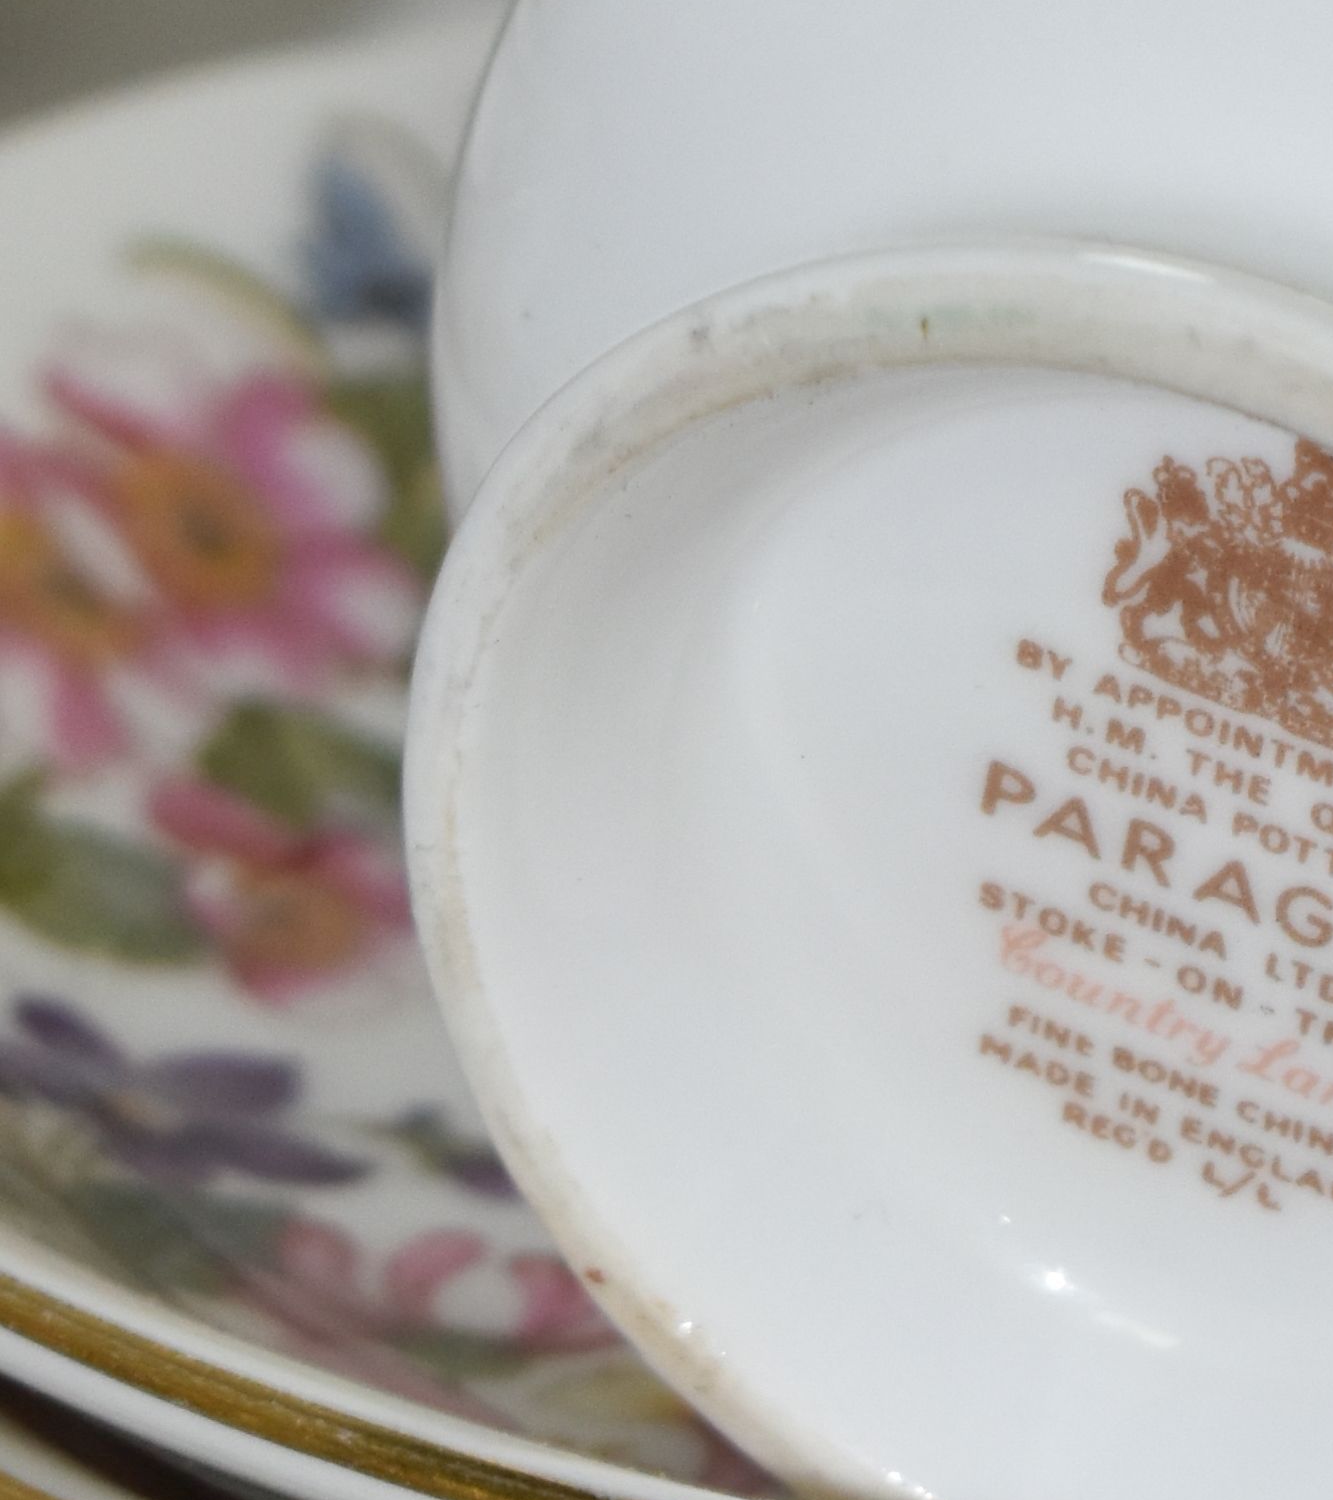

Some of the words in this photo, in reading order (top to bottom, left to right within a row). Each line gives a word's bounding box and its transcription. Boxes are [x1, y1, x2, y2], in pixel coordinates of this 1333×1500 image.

[1016, 639, 1073, 680] BY
[1067, 746, 1208, 824] CHINA
[1187, 749, 1272, 805] THE
[1088, 882, 1227, 960] CHINA
[998, 921, 1232, 1066] Country
[978, 1034, 1096, 1097] MADE
[1119, 1093, 1160, 1126] IN
[1007, 1004, 1095, 1057] FINE
[1111, 1046, 1221, 1106] BONE
